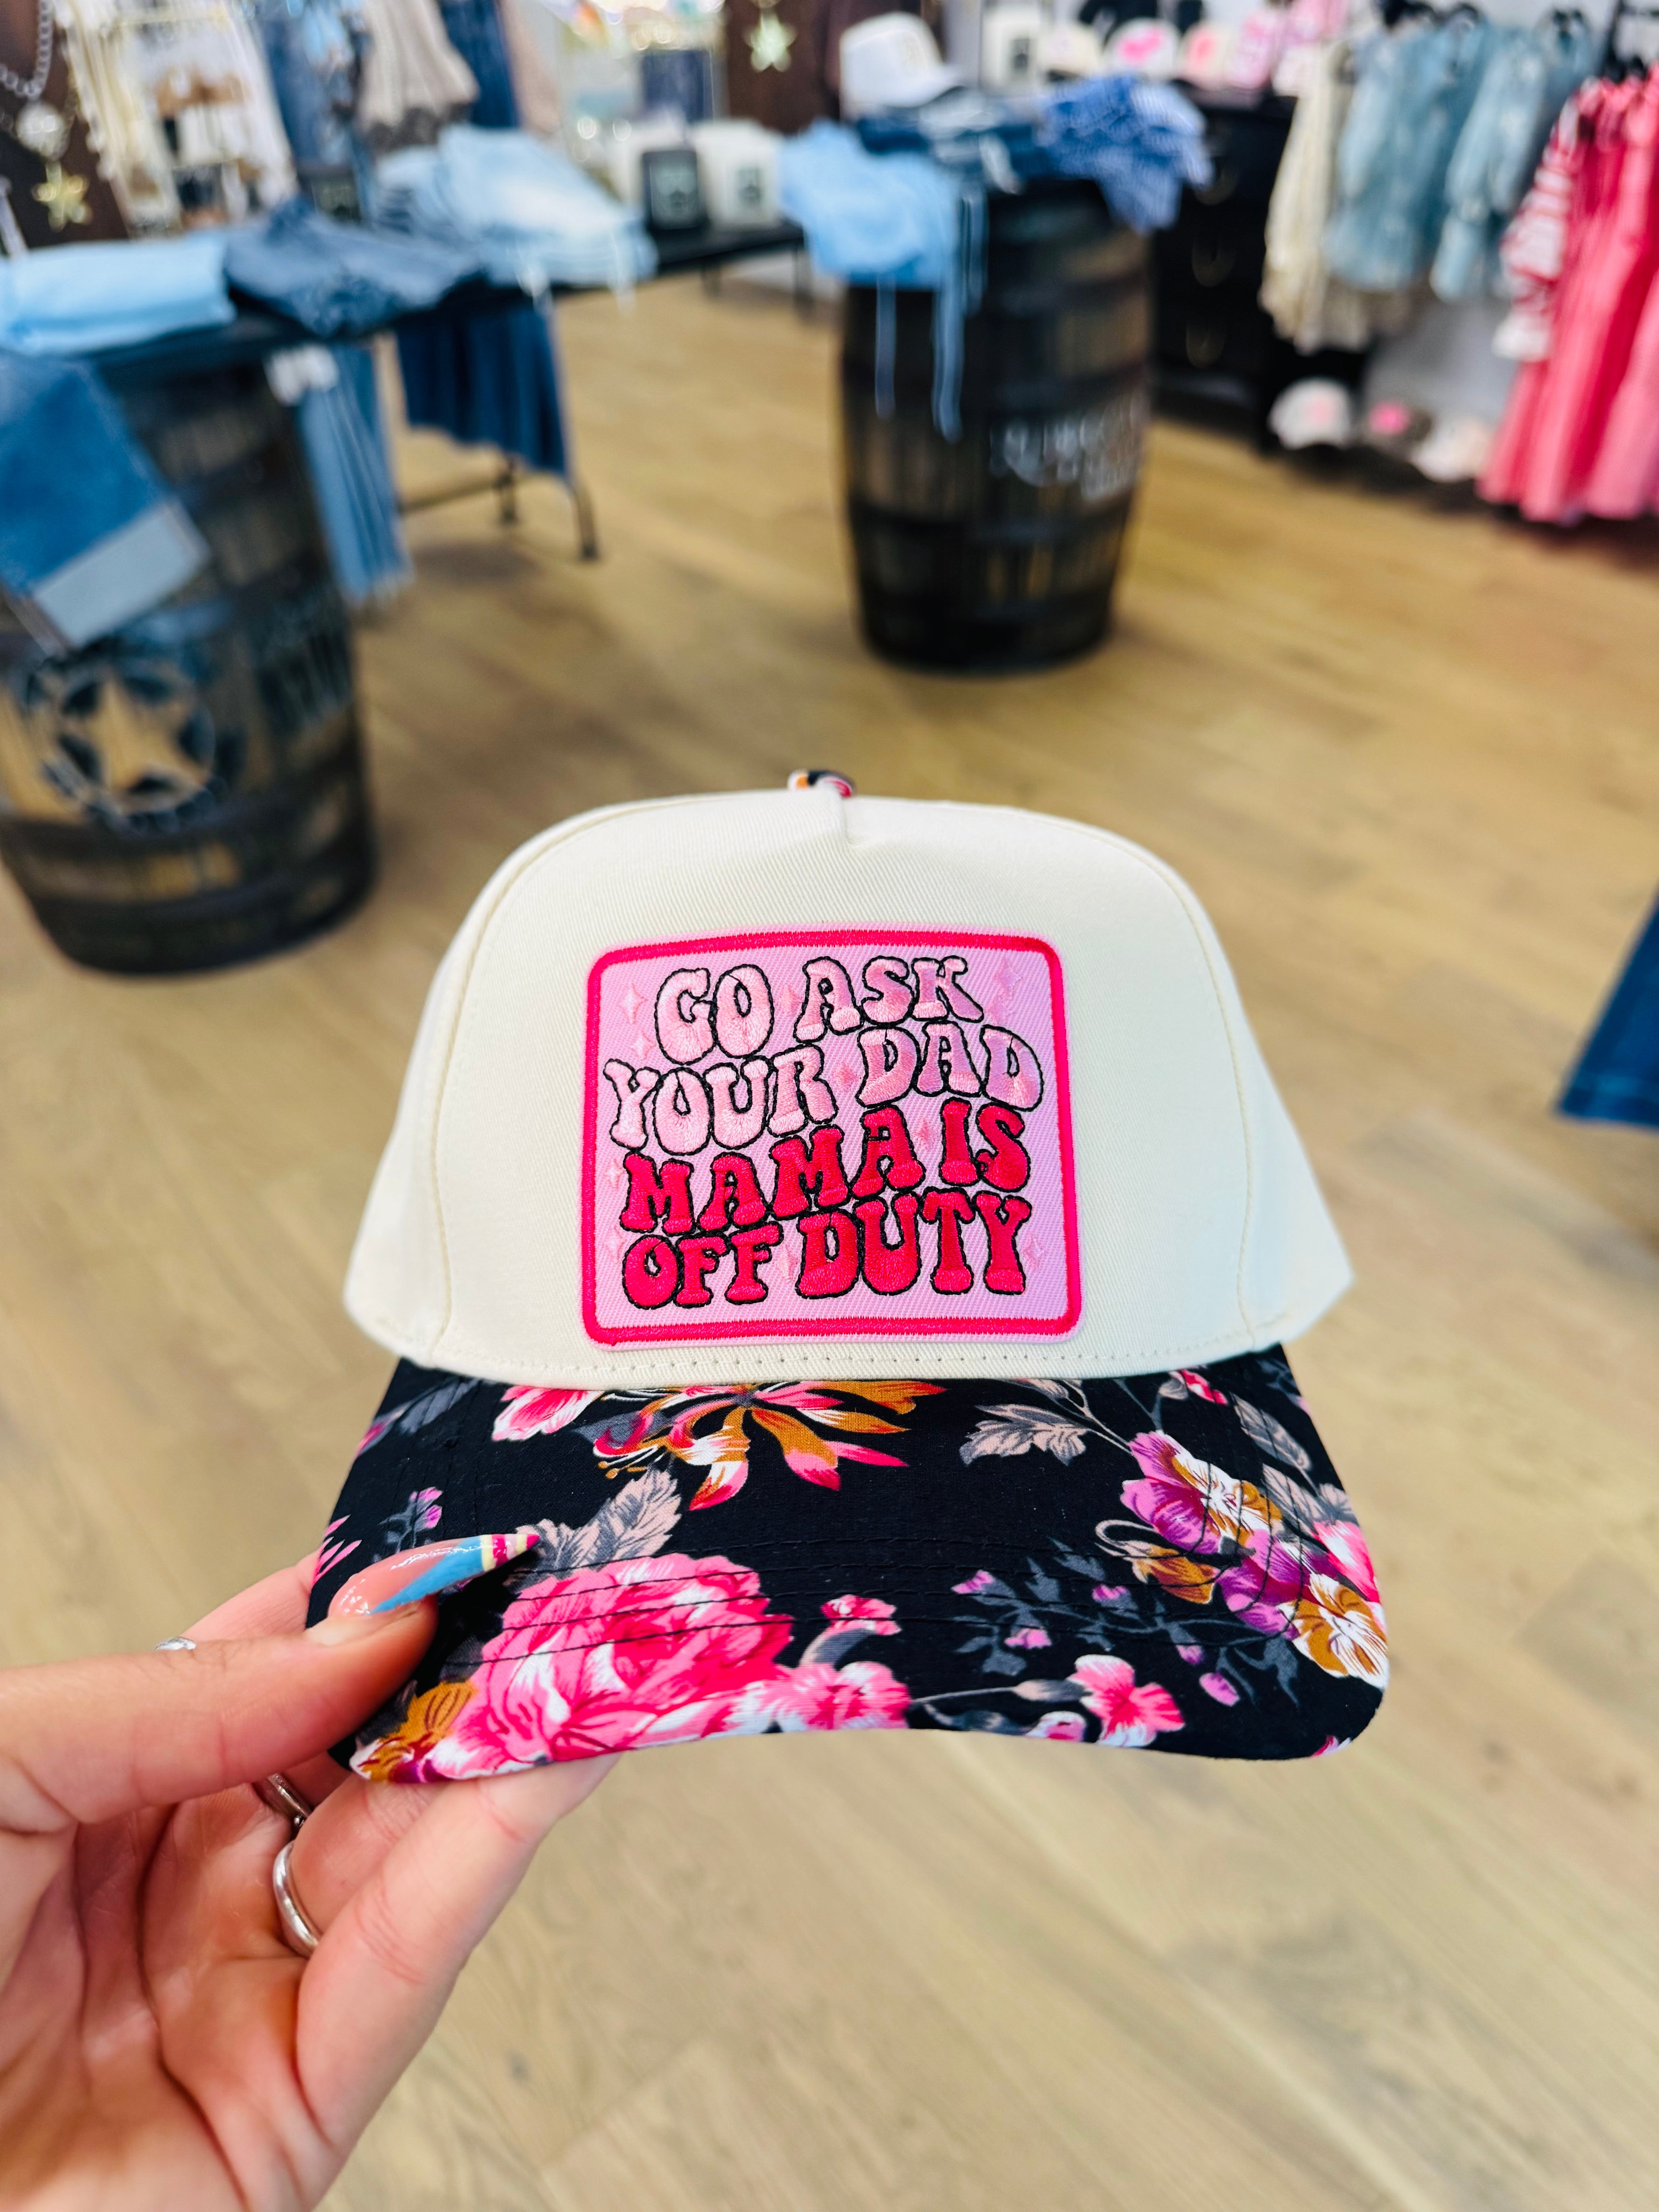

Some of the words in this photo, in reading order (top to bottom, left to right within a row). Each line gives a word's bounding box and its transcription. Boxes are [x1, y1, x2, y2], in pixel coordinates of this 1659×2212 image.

[655, 963, 775, 1065] GO
[794, 956, 984, 1043] ASK
[604, 1043, 838, 1155] YOUR
[856, 1020, 1043, 1112] DAD
[620, 1104, 925, 1235] MAMA
[938, 1097, 1031, 1192] IS
[623, 1221, 784, 1309] OFF
[795, 1187, 1033, 1299] DUTY
